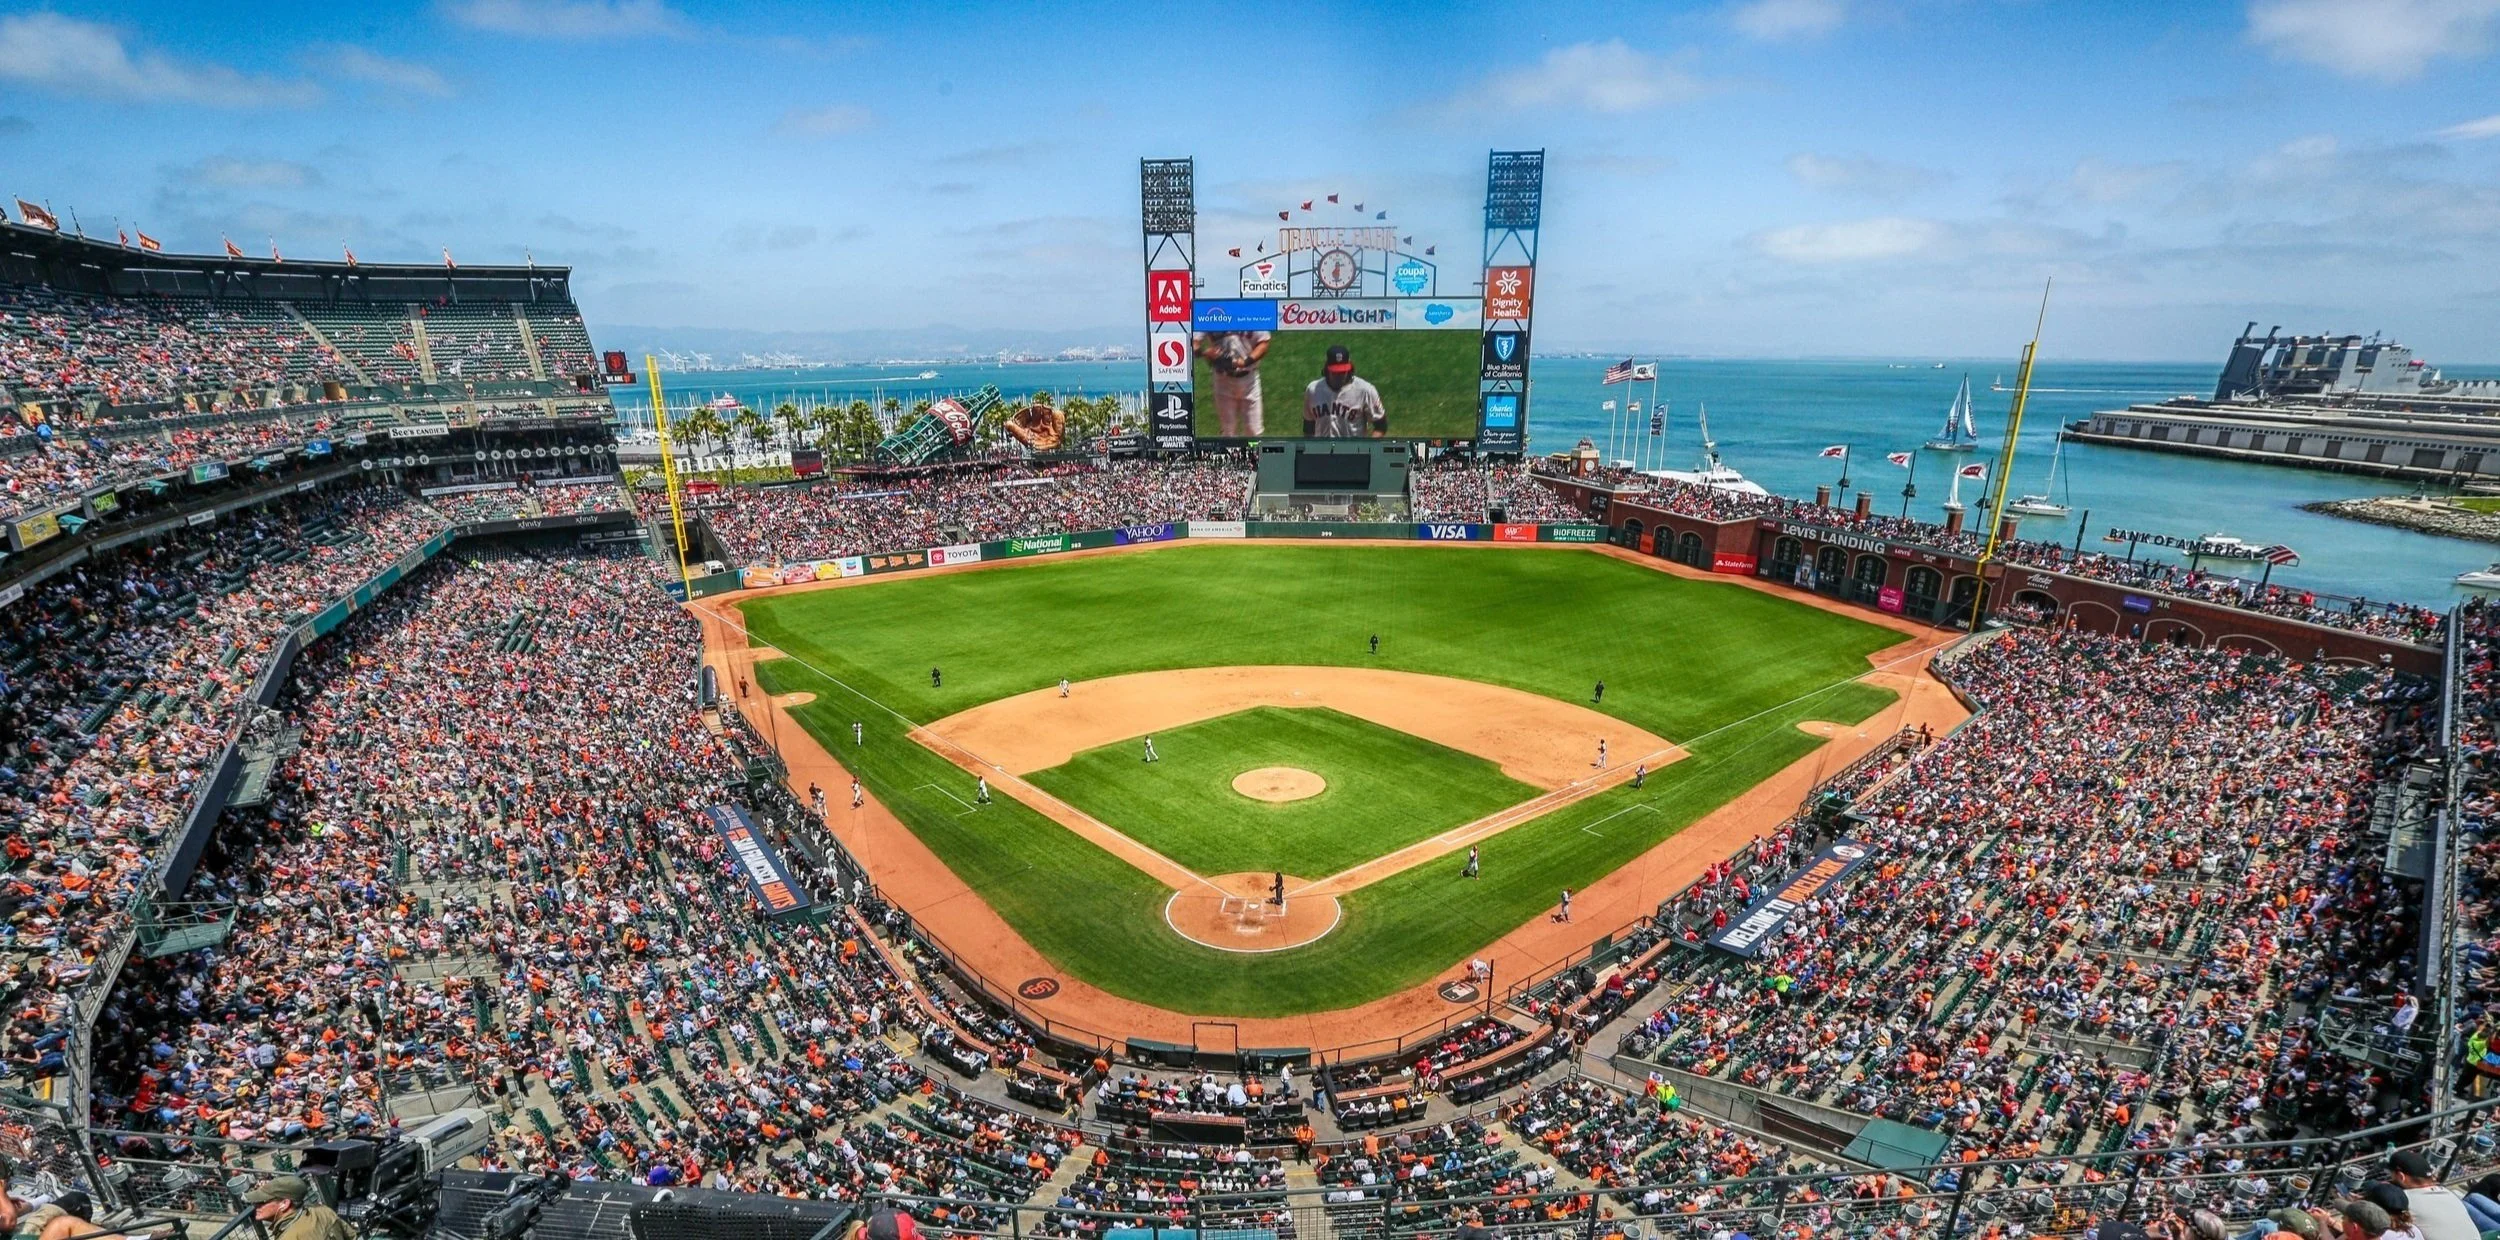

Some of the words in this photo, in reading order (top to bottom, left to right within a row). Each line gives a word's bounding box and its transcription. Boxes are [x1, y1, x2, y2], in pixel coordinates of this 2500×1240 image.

[1279, 228, 1345, 254] ORACLE
[1353, 229, 1398, 254] PARK
[1398, 267, 1425, 277] coupa
[1242, 281, 1287, 291] Fanatics
[1492, 298, 1523, 309] Dignity
[1159, 305, 1182, 314] Adobe
[1282, 302, 1337, 326] Coors
[1339, 308, 1386, 324] LIGHT
[1197, 313, 1233, 323] workday
[1486, 363, 1500, 371] Blue
[1501, 363, 1521, 371] Shield
[606, 375, 614, 383] WE
[614, 375, 624, 383] ARE
[1484, 370, 1491, 378] of
[1489, 404, 1513, 413] charles
[391, 428, 415, 437] See's
[416, 427, 445, 435] CANDIES
[1156, 435, 1193, 443] GREATNESS
[673, 452, 788, 475] nuveen
[517, 520, 542, 529] xfinity
[575, 515, 598, 524] xfinity
[1125, 526, 1165, 540] YAHOO!
[1428, 525, 1467, 539] VISA
[1553, 528, 1596, 537] BIOFREEZE
[1023, 536, 1063, 550] National
[1820, 531, 1886, 554] LANDING
[2109, 527, 2151, 544] BANK
[2154, 534, 2174, 547] OF
[2177, 538, 2254, 560] AMERICA
[947, 549, 978, 559] TOYOTA
[1956, 618, 1970, 628] 309
[1719, 908, 1784, 949] WELCOME
